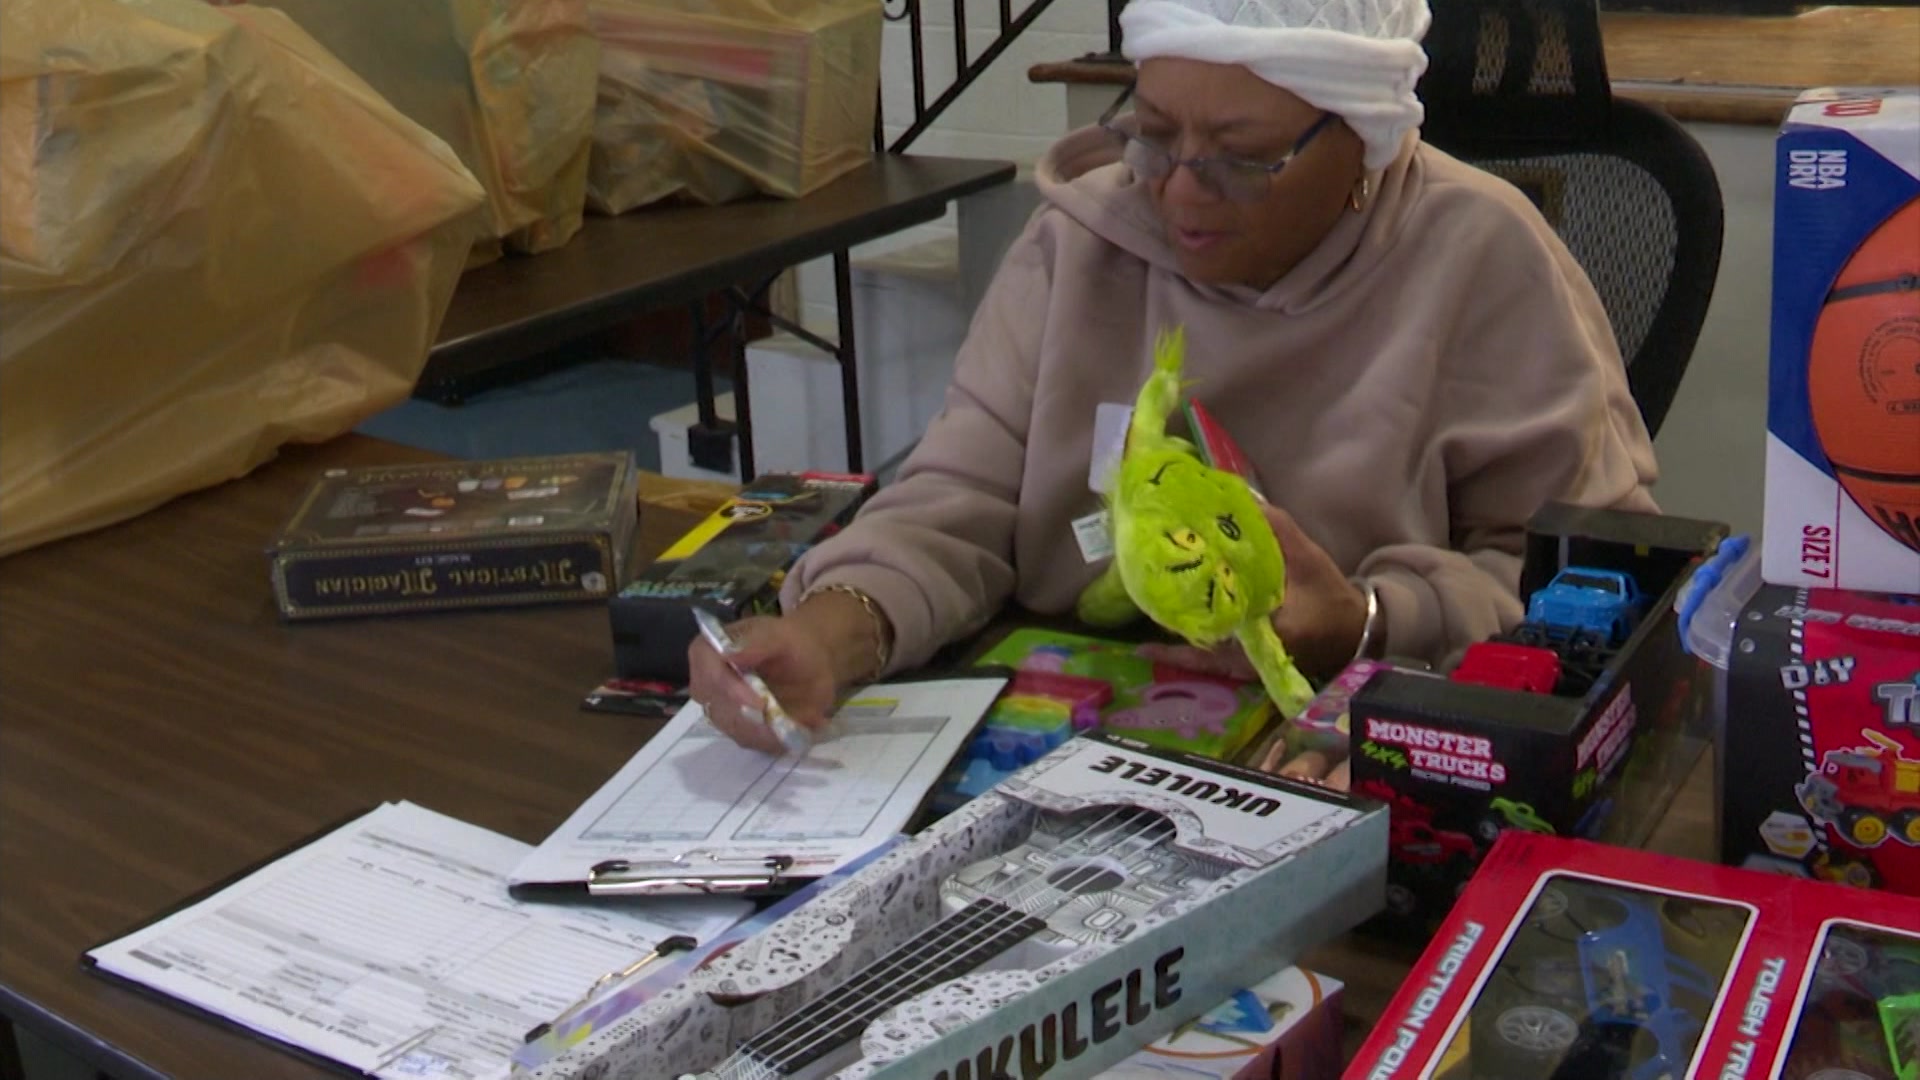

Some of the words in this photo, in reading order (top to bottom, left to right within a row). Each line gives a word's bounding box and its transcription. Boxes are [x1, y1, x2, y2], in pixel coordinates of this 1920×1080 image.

[1789, 150, 1818, 189] DRV
[1818, 150, 1848, 189] NBA
[1802, 525, 1831, 564] SIZE
[1801, 568, 1830, 579] 7
[1367, 718, 1492, 759] MONSTER
[1409, 749, 1506, 782] TRUCKS
[1088, 755, 1281, 817] UKULELE
[1402, 921, 1485, 1030] FRICTION
[1738, 957, 1787, 1038] TOUGH
